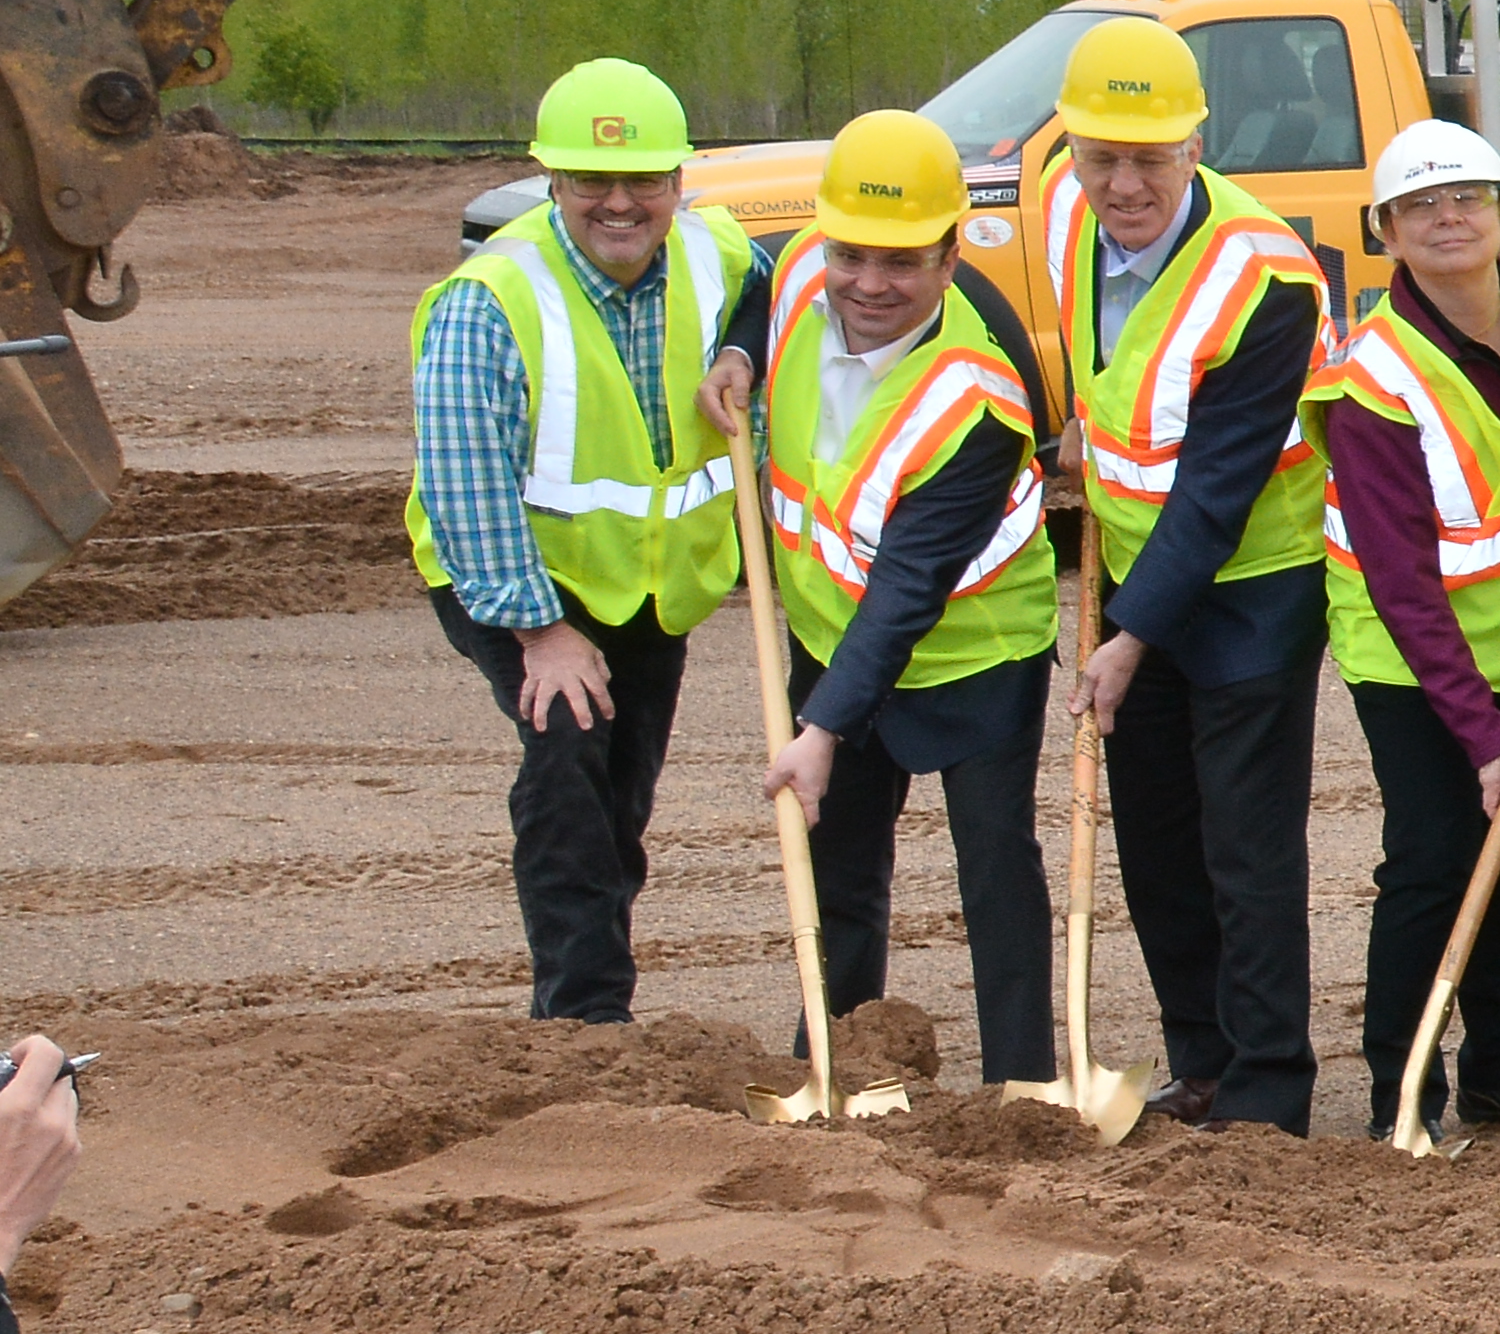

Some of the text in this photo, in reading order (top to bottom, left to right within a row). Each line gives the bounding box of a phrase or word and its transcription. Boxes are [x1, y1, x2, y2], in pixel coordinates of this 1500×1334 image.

[1108, 79, 1151, 92] RYAN
[859, 182, 903, 198] RYAN
[727, 199, 816, 216] NCOMPAN
